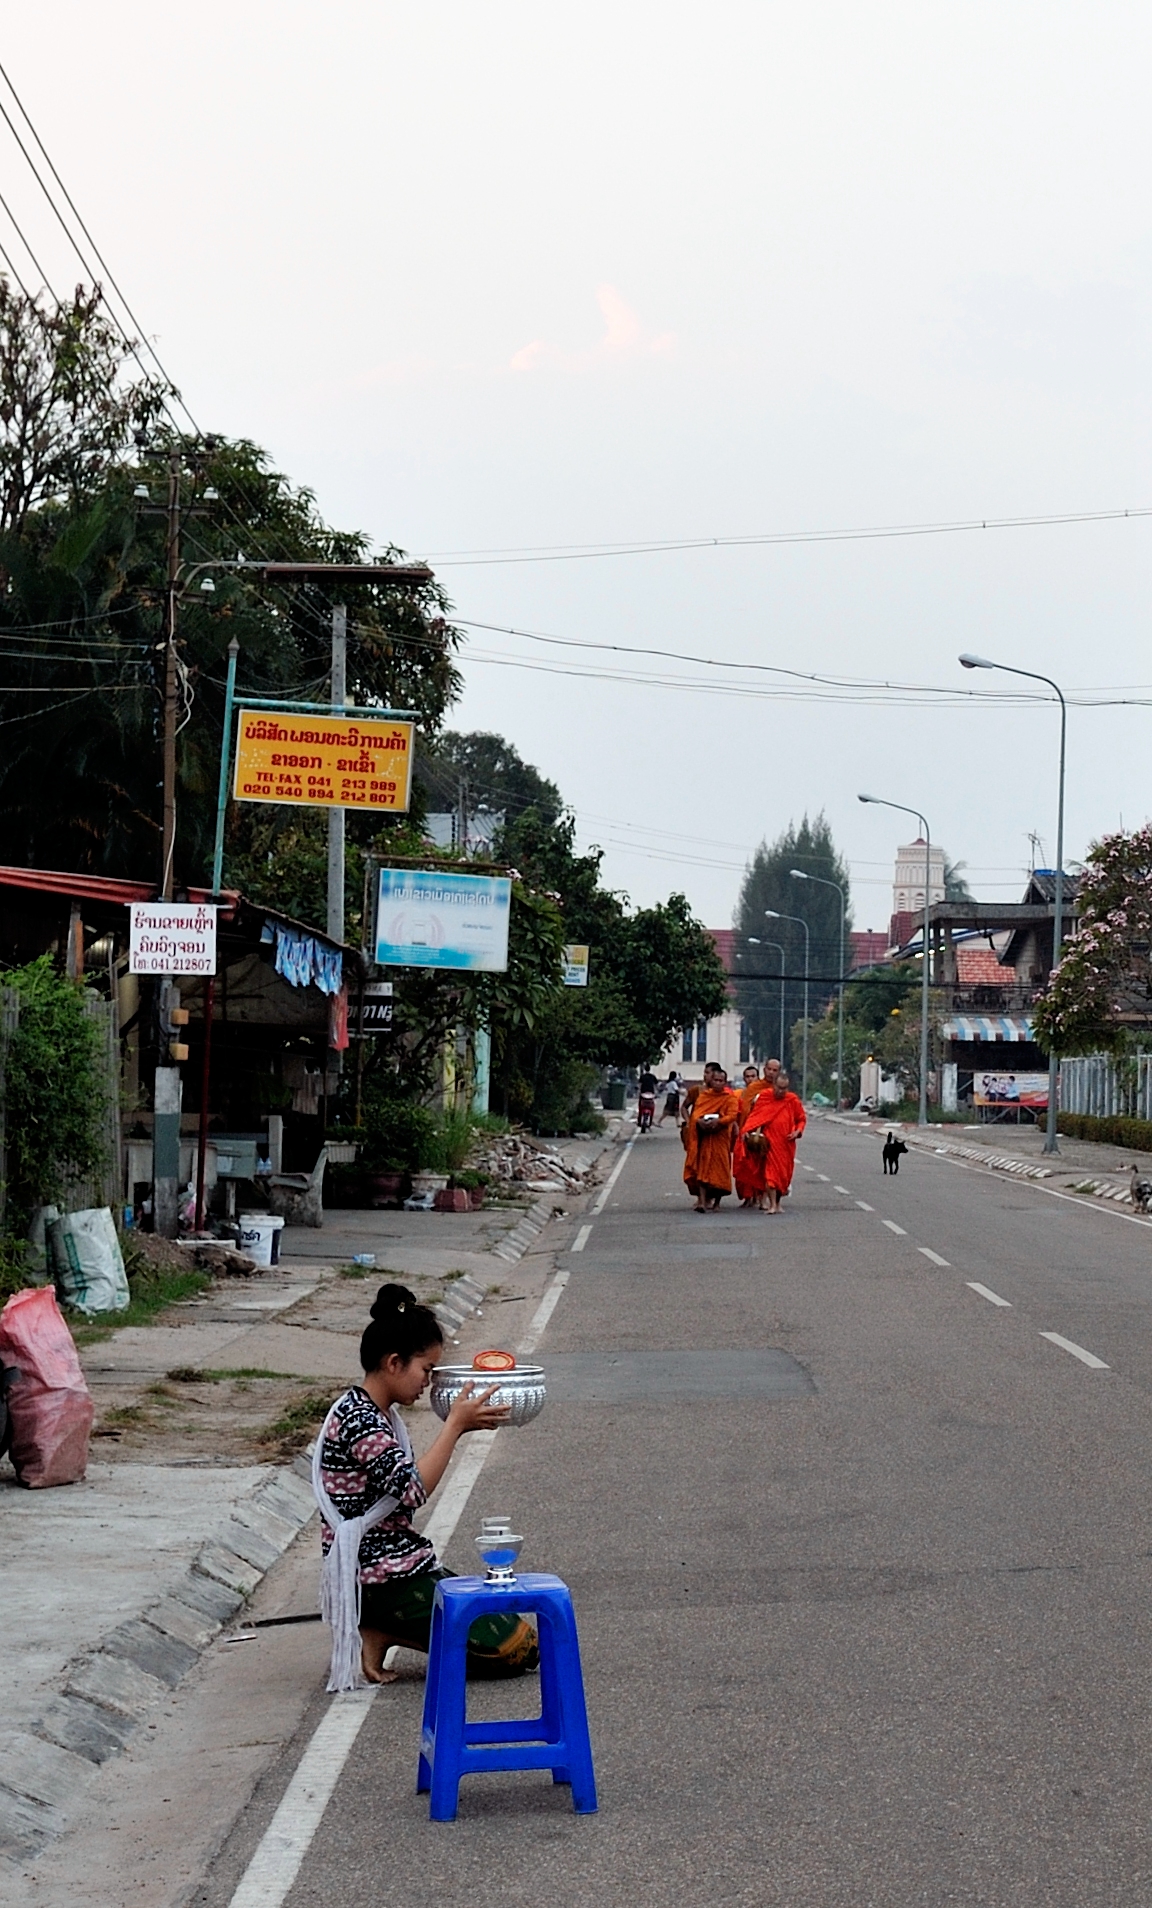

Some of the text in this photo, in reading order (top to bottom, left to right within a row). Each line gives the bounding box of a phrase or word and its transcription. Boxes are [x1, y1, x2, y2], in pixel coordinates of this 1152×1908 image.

[307, 775, 331, 787] 041
[341, 778, 366, 790] 213
[370, 780, 397, 792] 989
[243, 783, 396, 805] 020 540 894 212 807
[151, 957, 169, 971] 041
[173, 957, 212, 971] 212807
